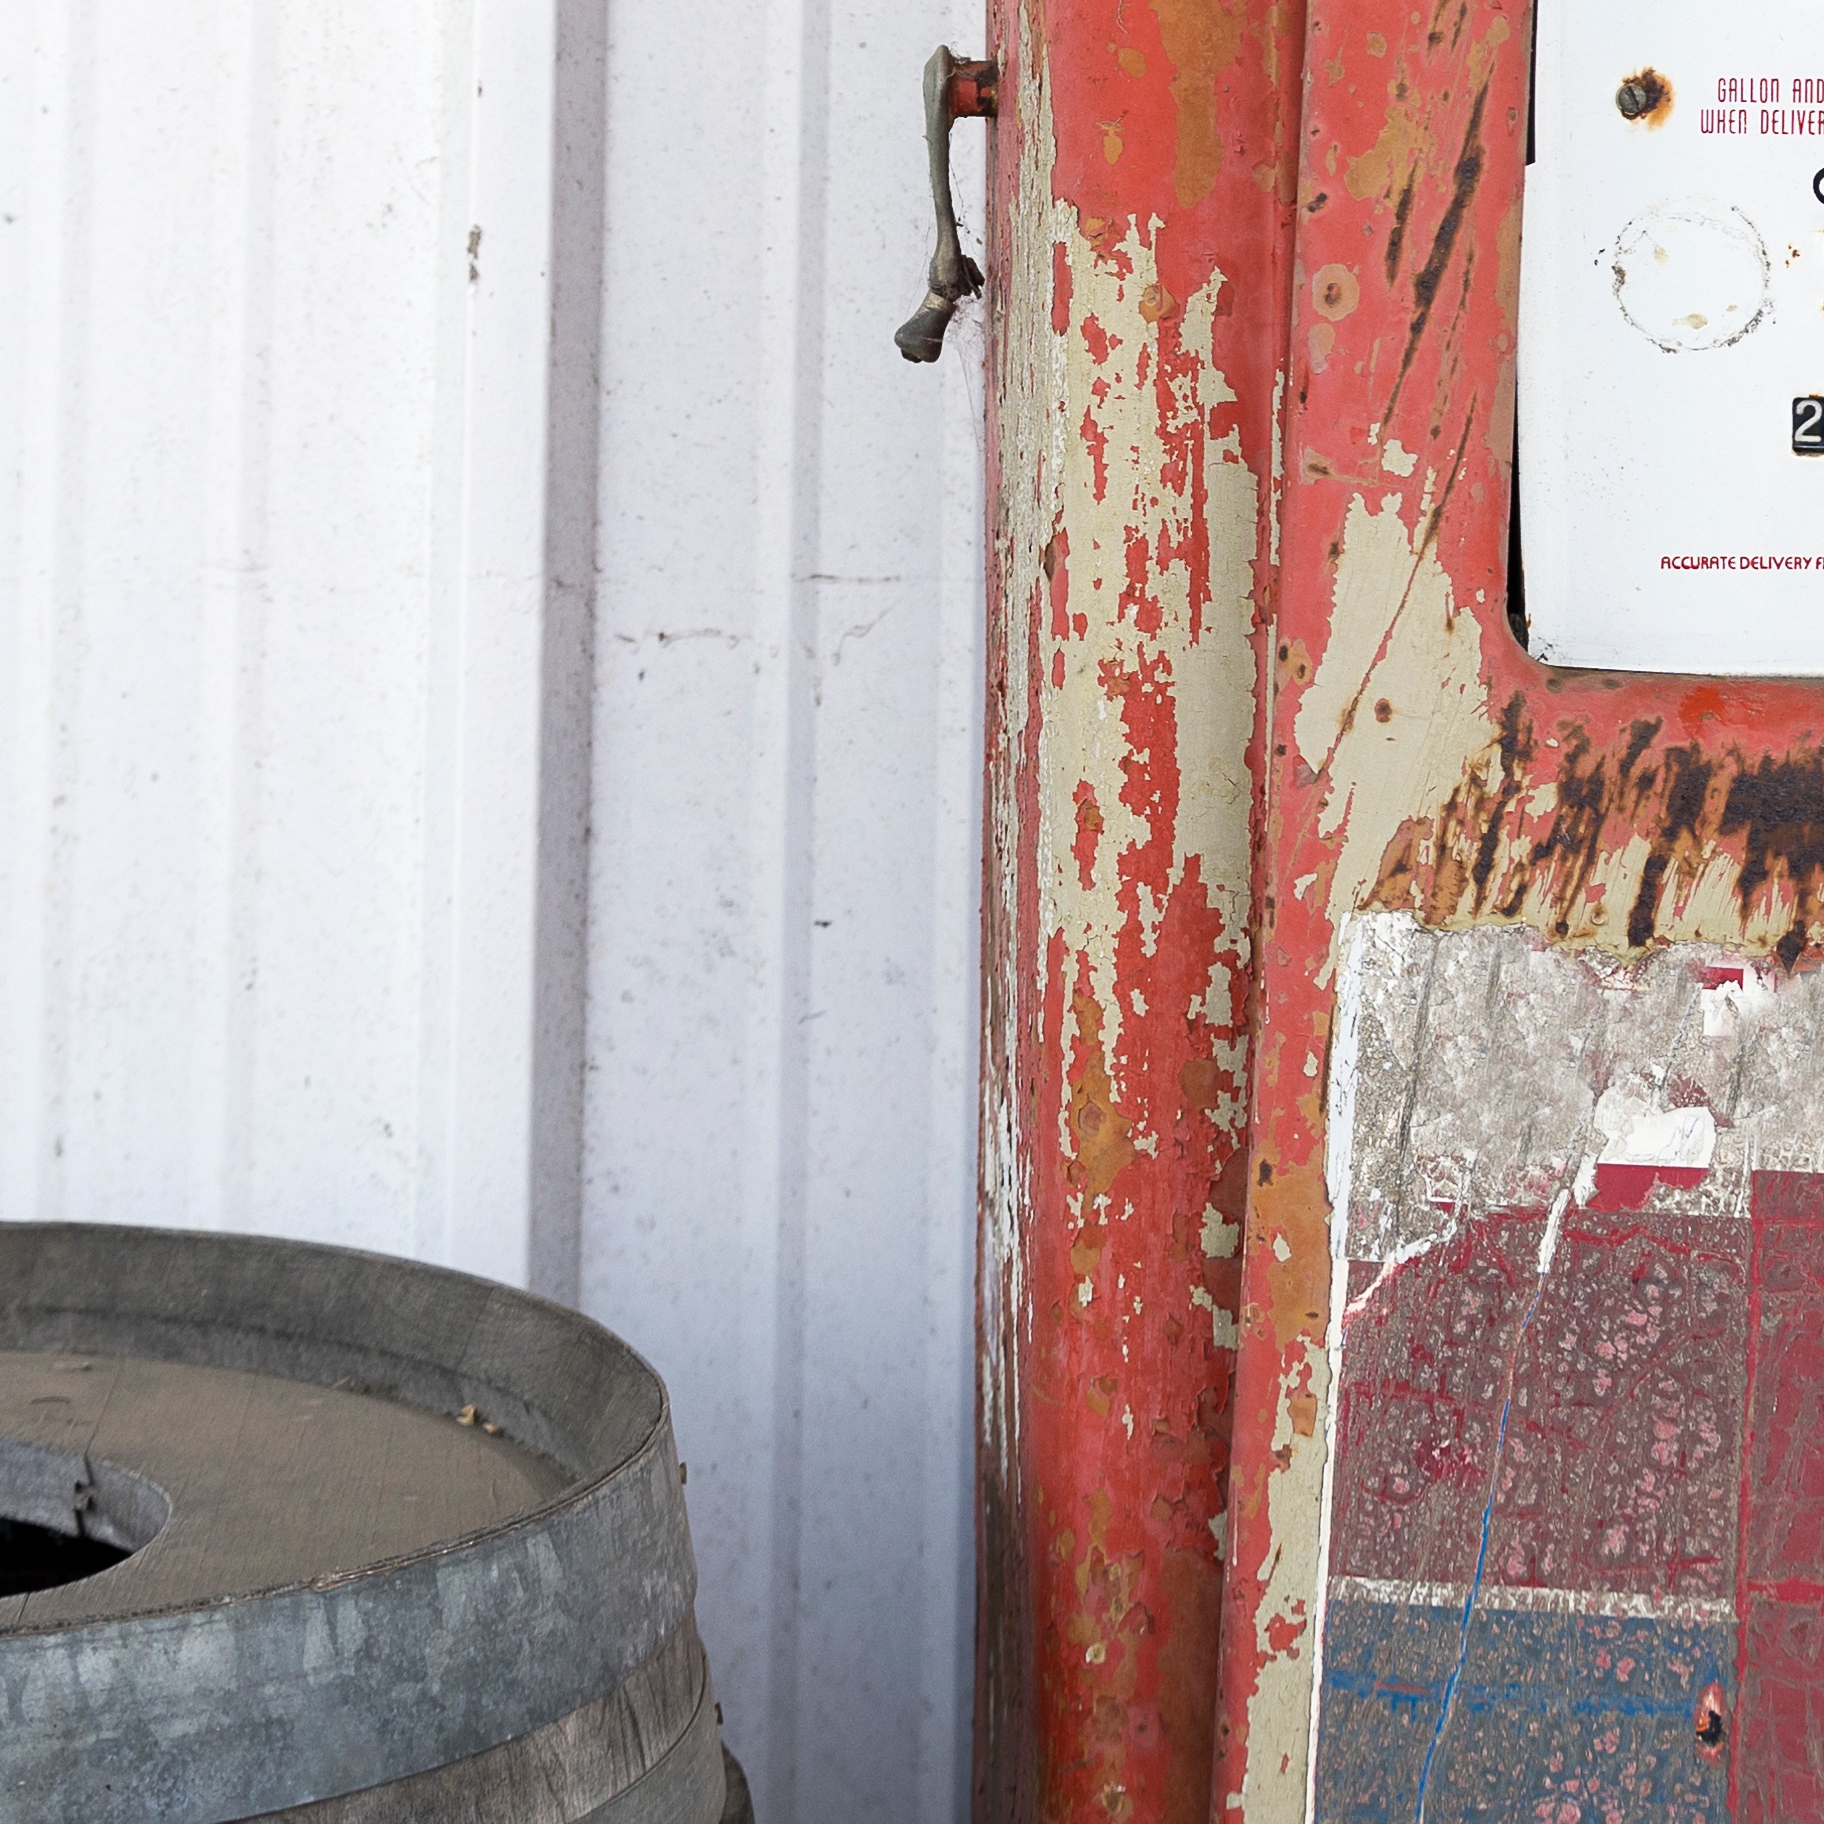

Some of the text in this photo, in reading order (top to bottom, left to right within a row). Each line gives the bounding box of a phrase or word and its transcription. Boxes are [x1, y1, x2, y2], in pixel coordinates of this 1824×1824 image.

[1717, 77, 1779, 103] GALLON
[1792, 78, 1824, 104] AND
[1700, 109, 1747, 135] WHEN
[1794, 399, 1823, 443] 2
[1660, 556, 1737, 571] ACCURATE
[1739, 556, 1813, 571] DELIVERY
